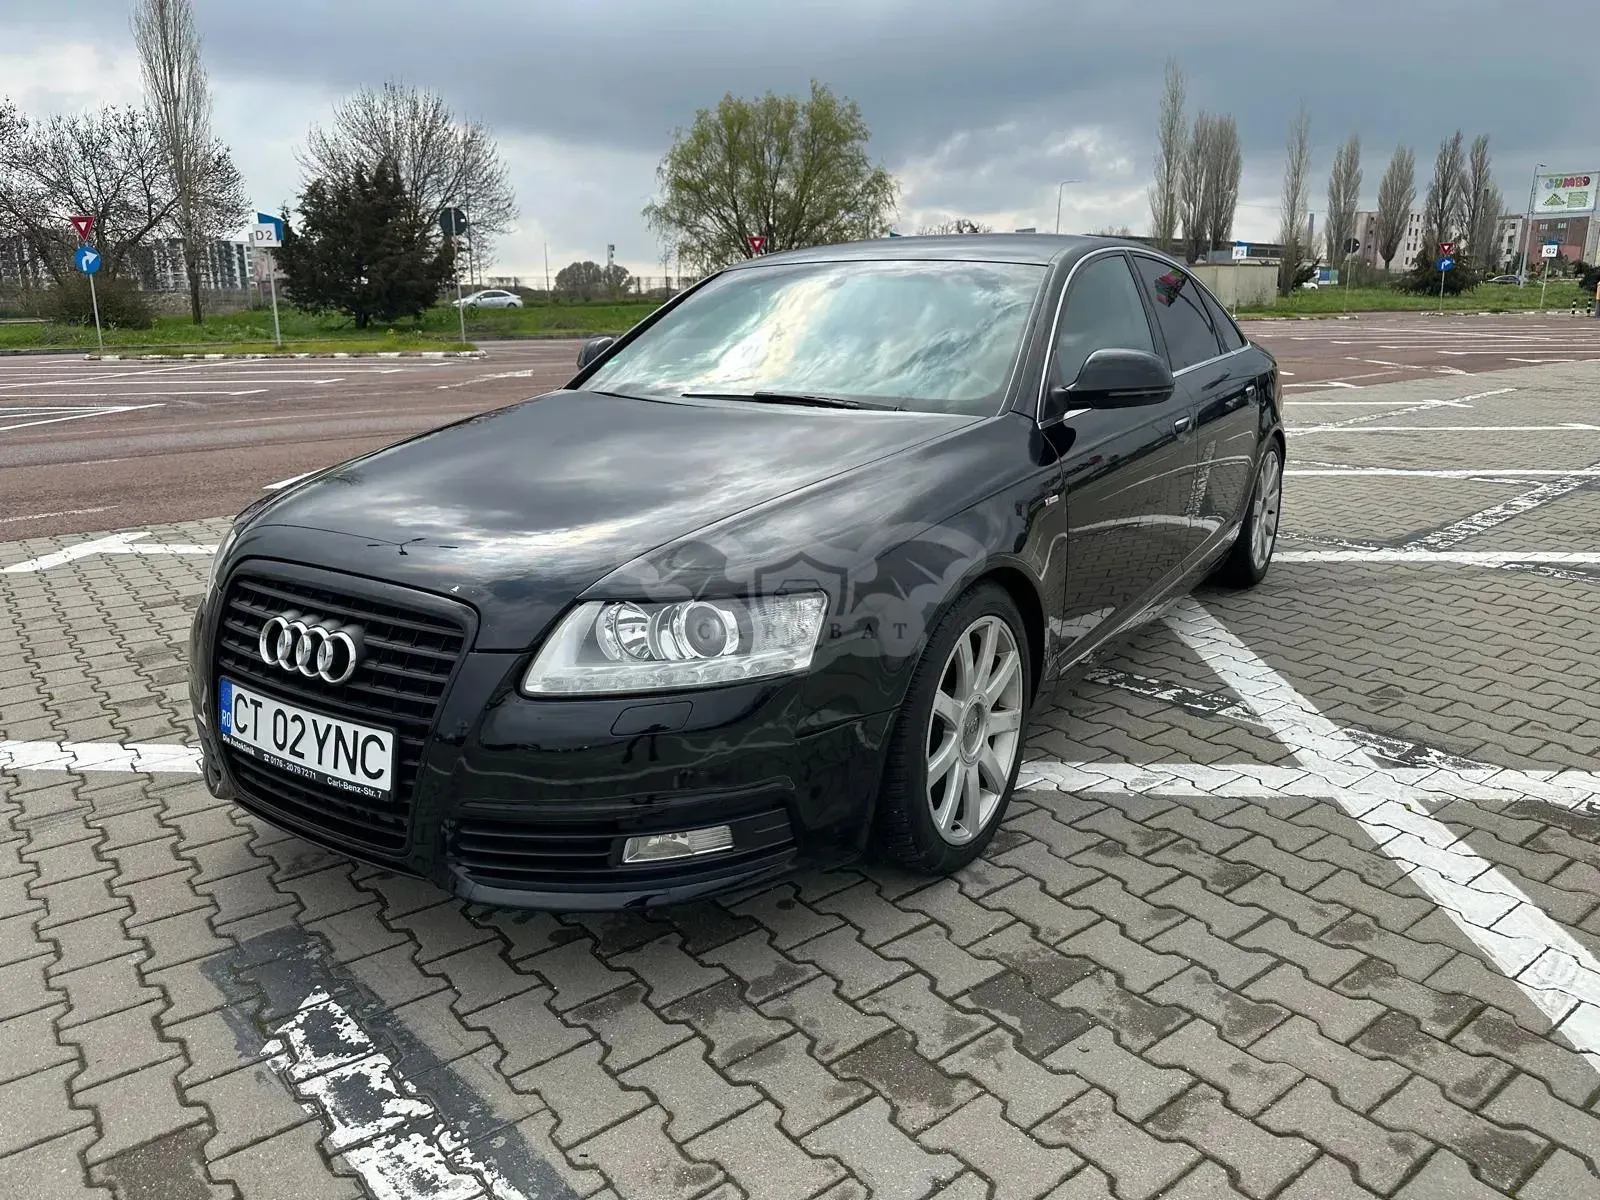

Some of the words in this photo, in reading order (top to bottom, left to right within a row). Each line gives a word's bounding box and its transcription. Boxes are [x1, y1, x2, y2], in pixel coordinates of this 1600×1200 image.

[1545, 176, 1591, 189] JUMBO
[255, 230, 273, 240] D2
[221, 710, 232, 727] RO
[234, 693, 263, 741] CT
[327, 777, 376, 798] Carl-Benz-Str.
[377, 790, 382, 799] 7
